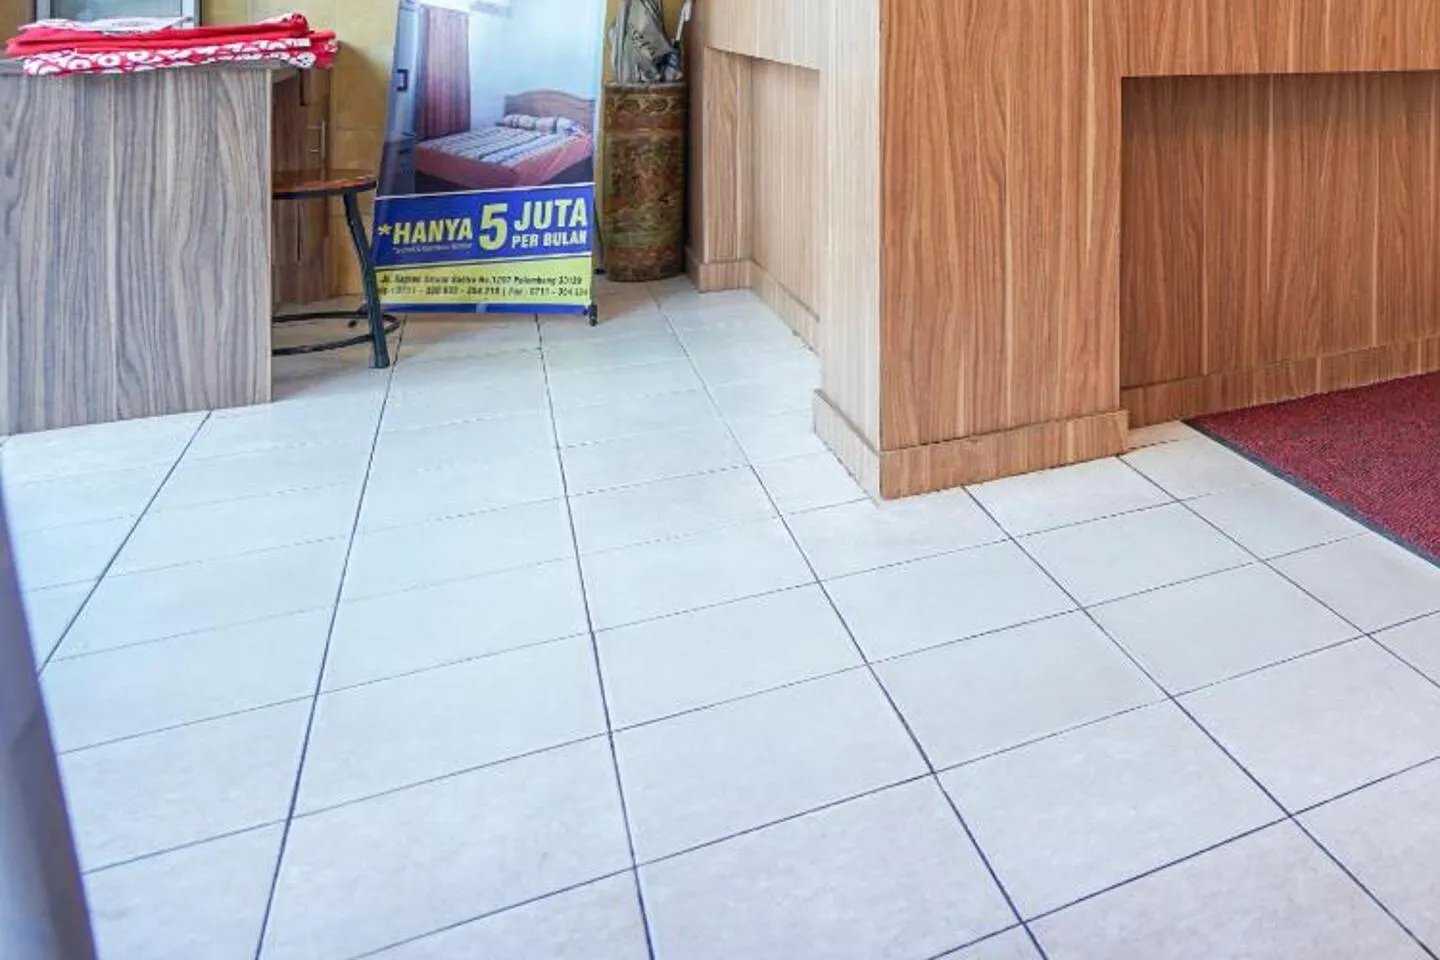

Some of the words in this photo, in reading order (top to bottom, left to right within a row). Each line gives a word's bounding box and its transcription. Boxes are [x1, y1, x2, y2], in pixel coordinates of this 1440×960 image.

[479, 202, 508, 251] 5
[513, 197, 588, 231] JUTA
[511, 233, 539, 248] PER
[542, 230, 587, 247] BULAN
